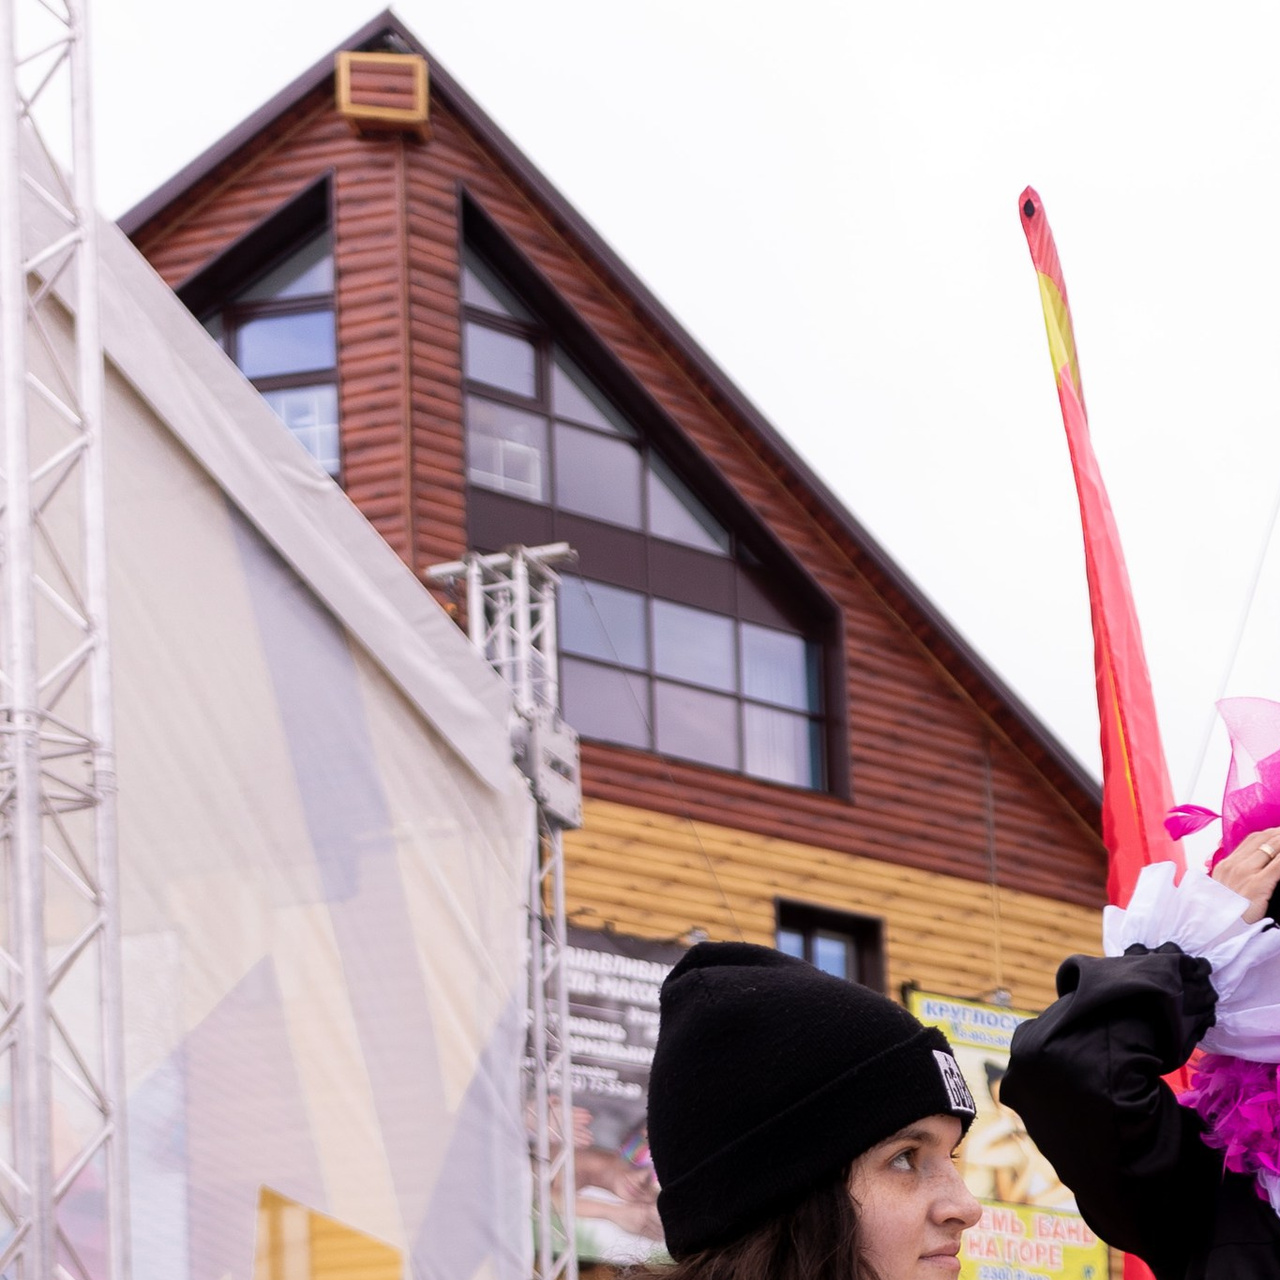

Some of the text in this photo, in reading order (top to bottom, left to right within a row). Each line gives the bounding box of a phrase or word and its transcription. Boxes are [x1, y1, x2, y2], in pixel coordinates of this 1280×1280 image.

[977, 1209, 1025, 1235] ЕМЬ
[968, 1236, 1062, 1269] НА ГОРЕ
